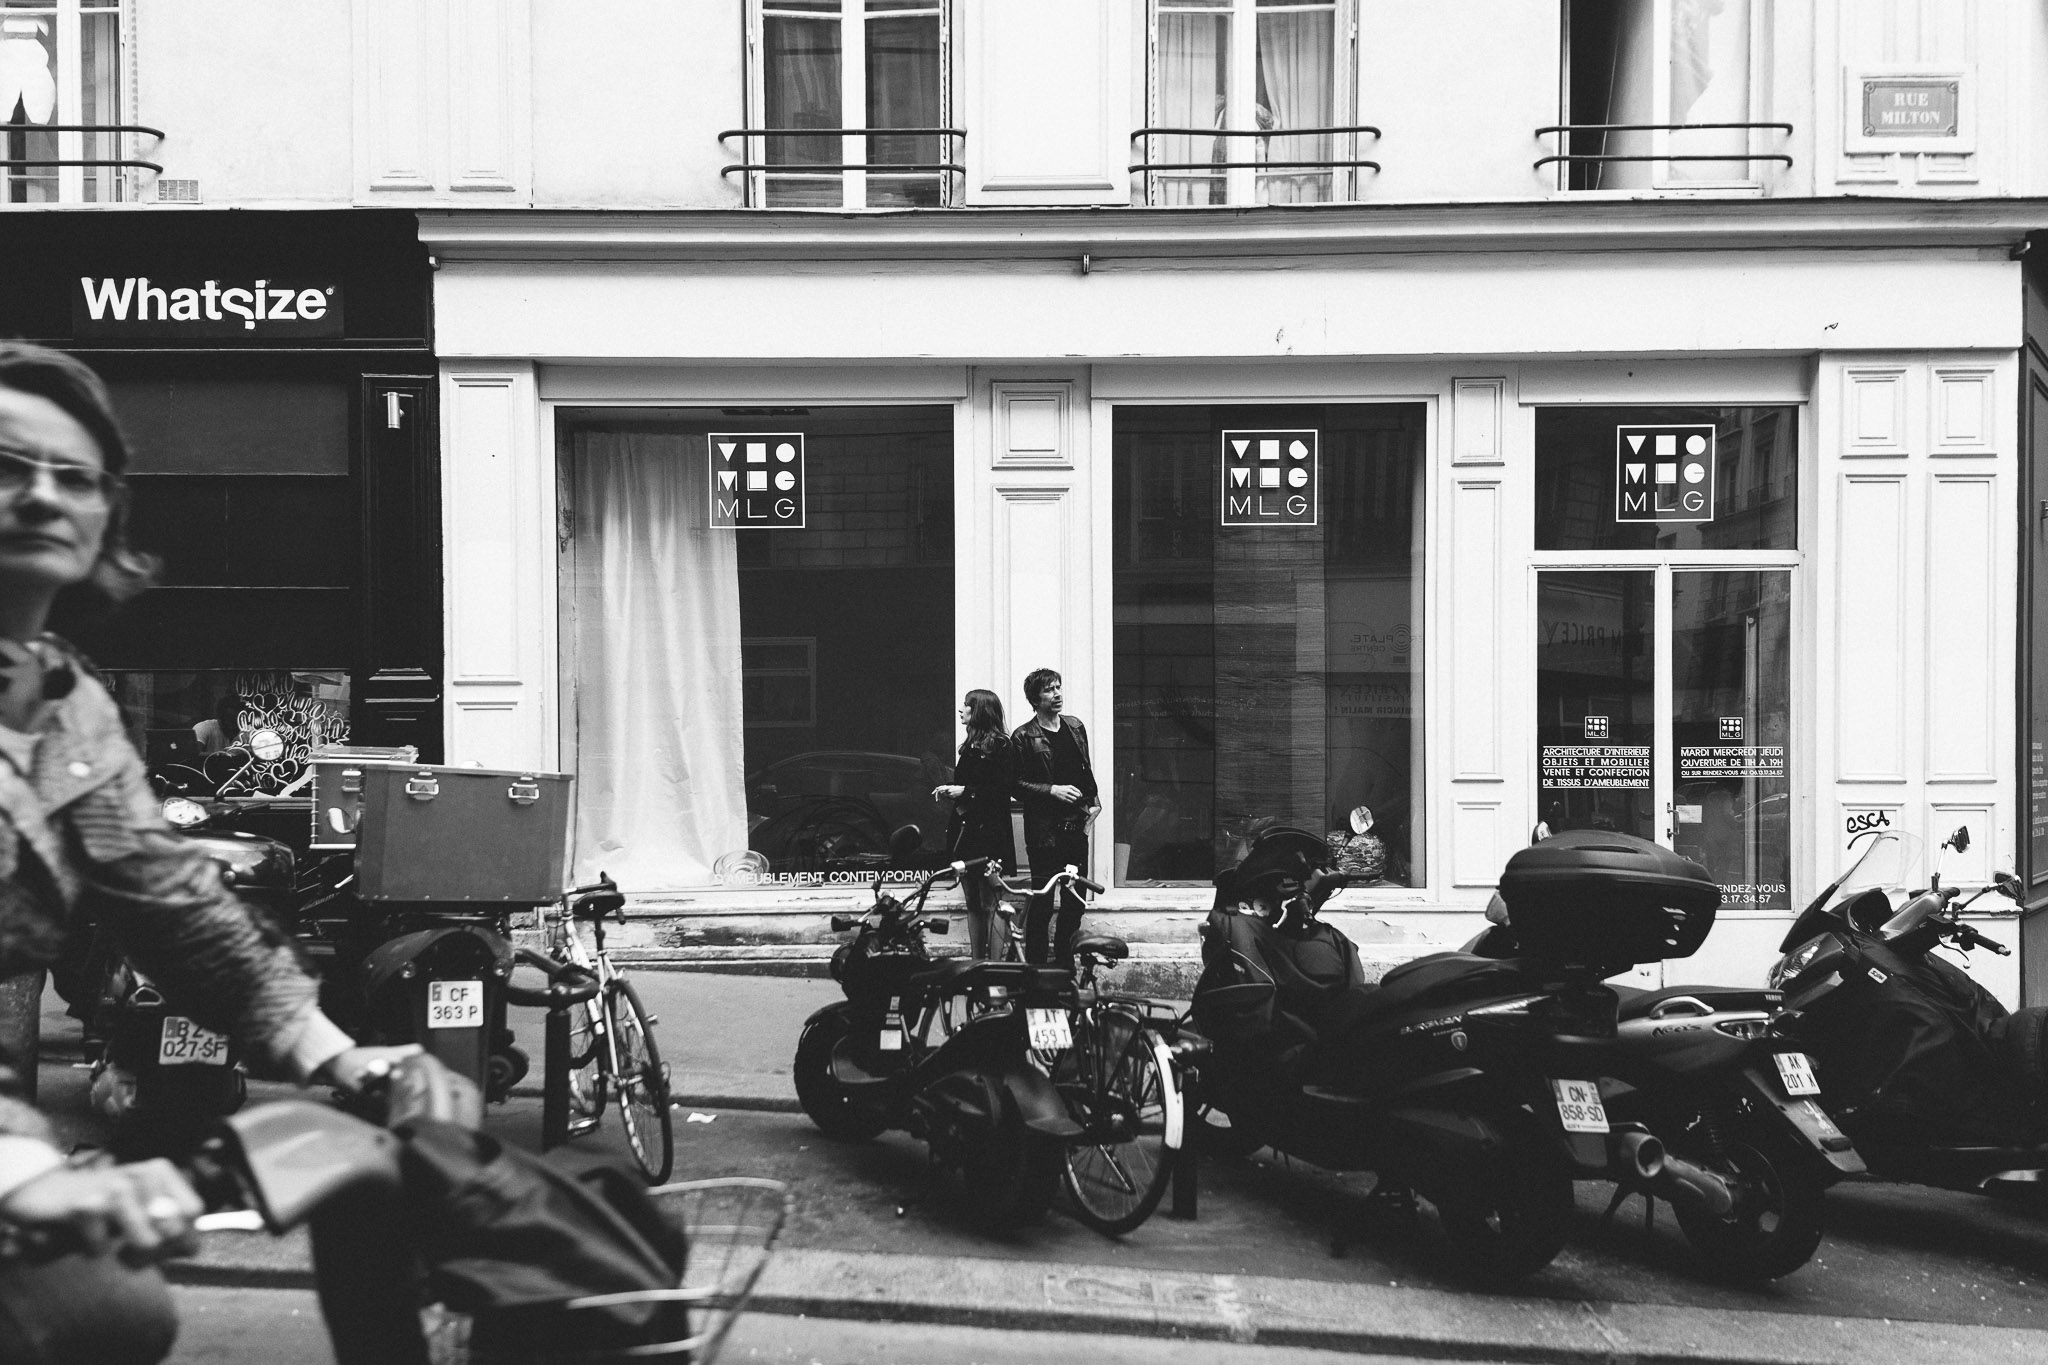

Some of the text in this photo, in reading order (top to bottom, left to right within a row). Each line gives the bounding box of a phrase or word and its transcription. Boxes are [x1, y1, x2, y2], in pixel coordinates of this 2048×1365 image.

[1894, 92, 1929, 106] RUE
[1881, 111, 1941, 125] MILTON
[1542, 748, 1601, 756] ARCHITECTURE
[1681, 748, 1783, 757] MARDI MERCREDI JEUDI
[1542, 758, 1650, 766] OBJETS ET MOBILIER
[1681, 758, 1727, 767] OUVERTURE
[1730, 758, 1741, 767] DE
[1770, 758, 1783, 767] 19H
[1543, 768, 1650, 777] VENTE ET CONFECTION
[1542, 778, 1650, 787] DE TISSUS D'AMEUBLEMENT
[1716, 884, 1786, 893] ENDEZ-VOUS
[1720, 894, 1772, 904] 3.17.34.57
[450, 988, 469, 1001] CF
